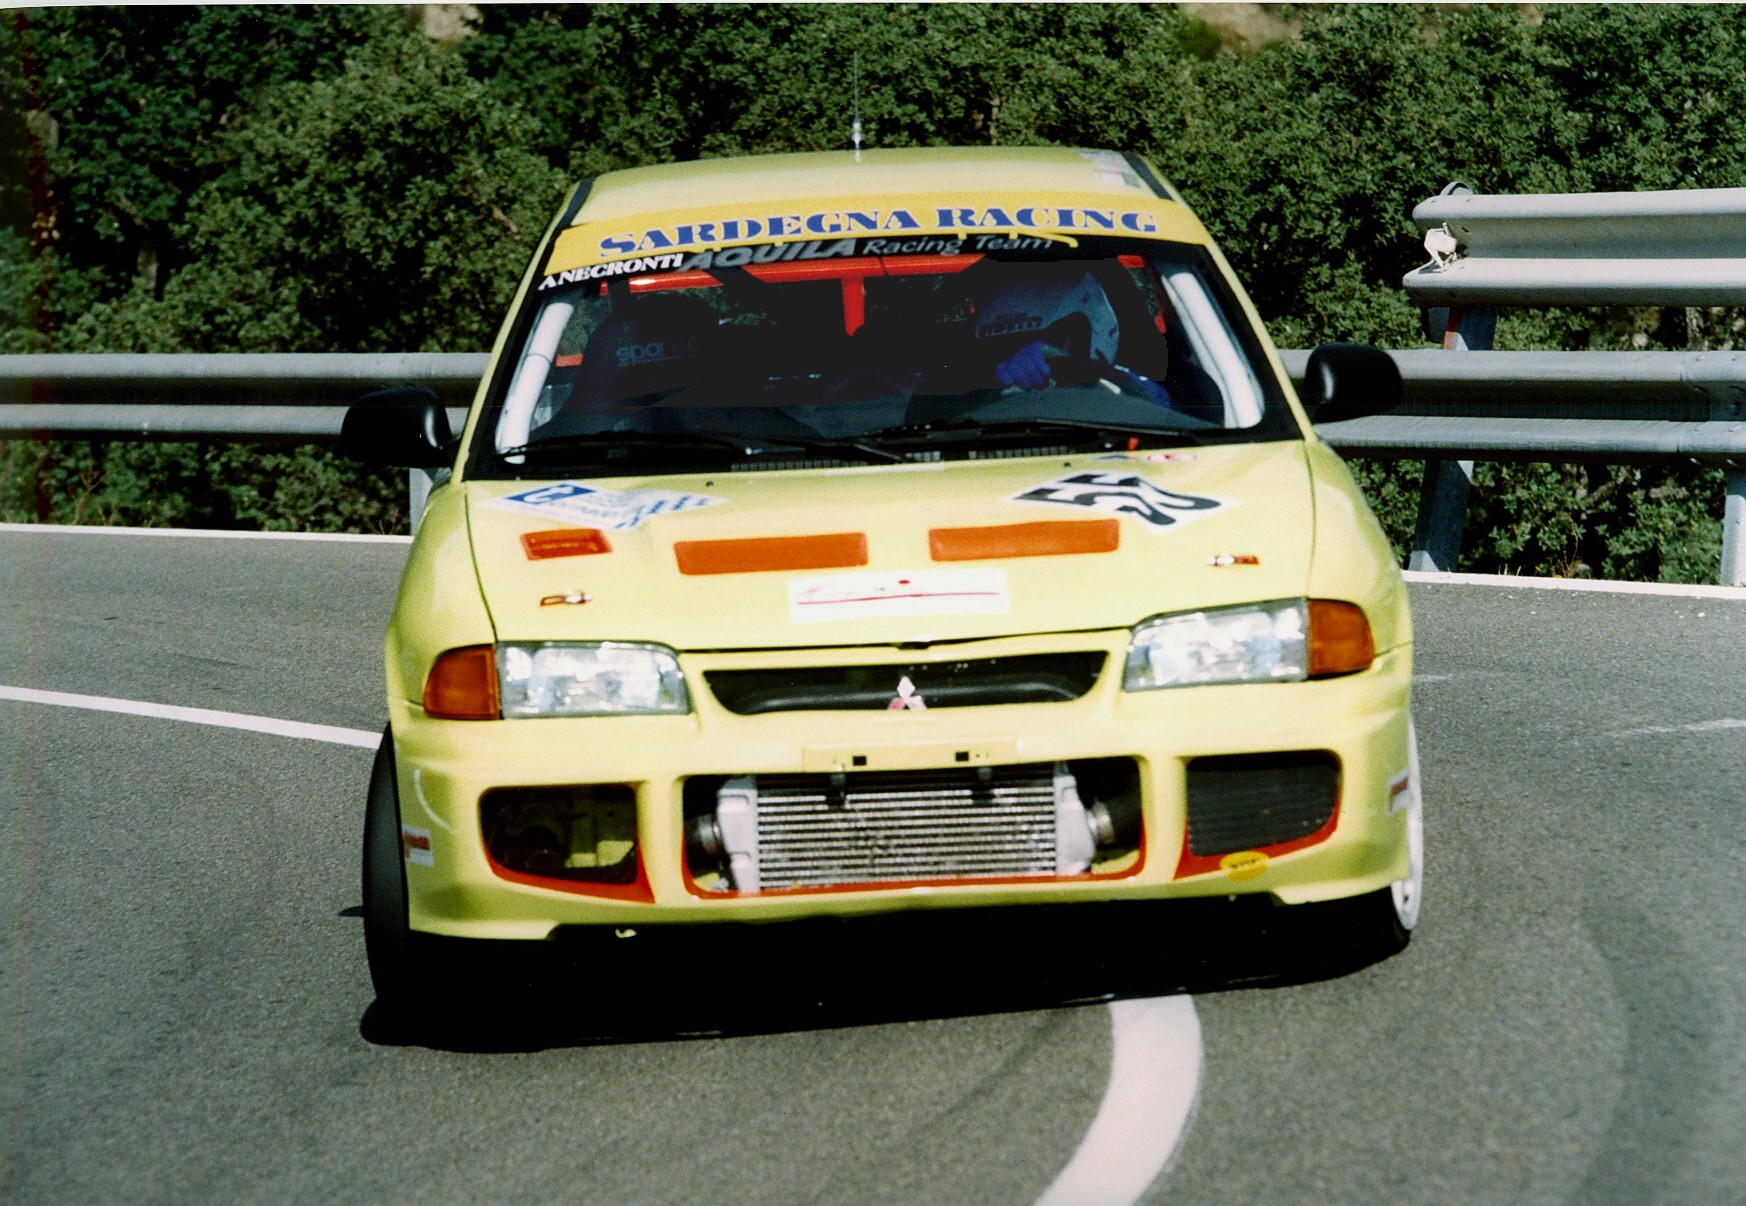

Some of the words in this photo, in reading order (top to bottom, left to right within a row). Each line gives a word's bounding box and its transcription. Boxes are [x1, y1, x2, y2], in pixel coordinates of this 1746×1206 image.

[600, 210, 921, 256] SARDEGNA
[936, 208, 1157, 233] RACING
[676, 238, 857, 272] AQUILA
[863, 236, 963, 256] Racing
[976, 234, 1054, 251] Team
